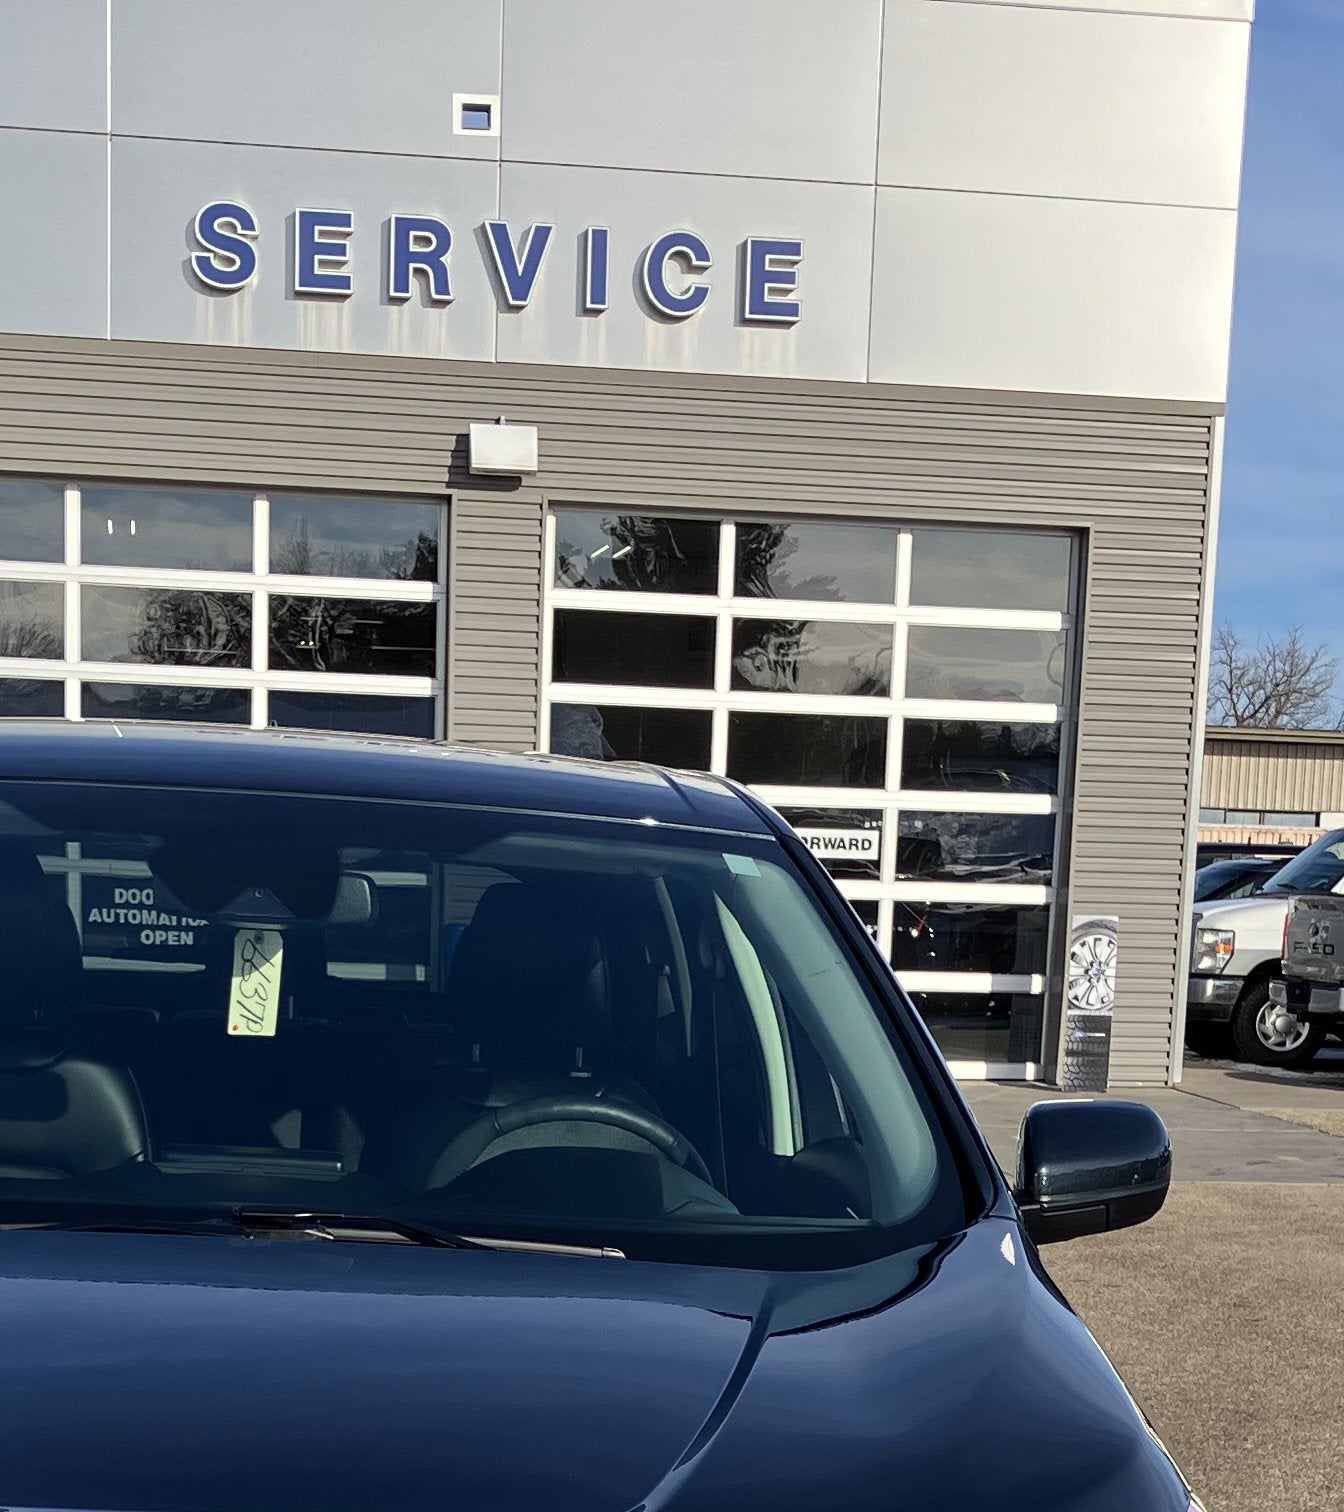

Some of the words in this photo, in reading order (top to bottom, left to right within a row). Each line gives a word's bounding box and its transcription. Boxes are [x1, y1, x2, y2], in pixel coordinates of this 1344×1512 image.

[190, 200, 805, 324] SERVICE
[800, 836, 873, 851] RWARD
[140, 930, 194, 946] OPEN
